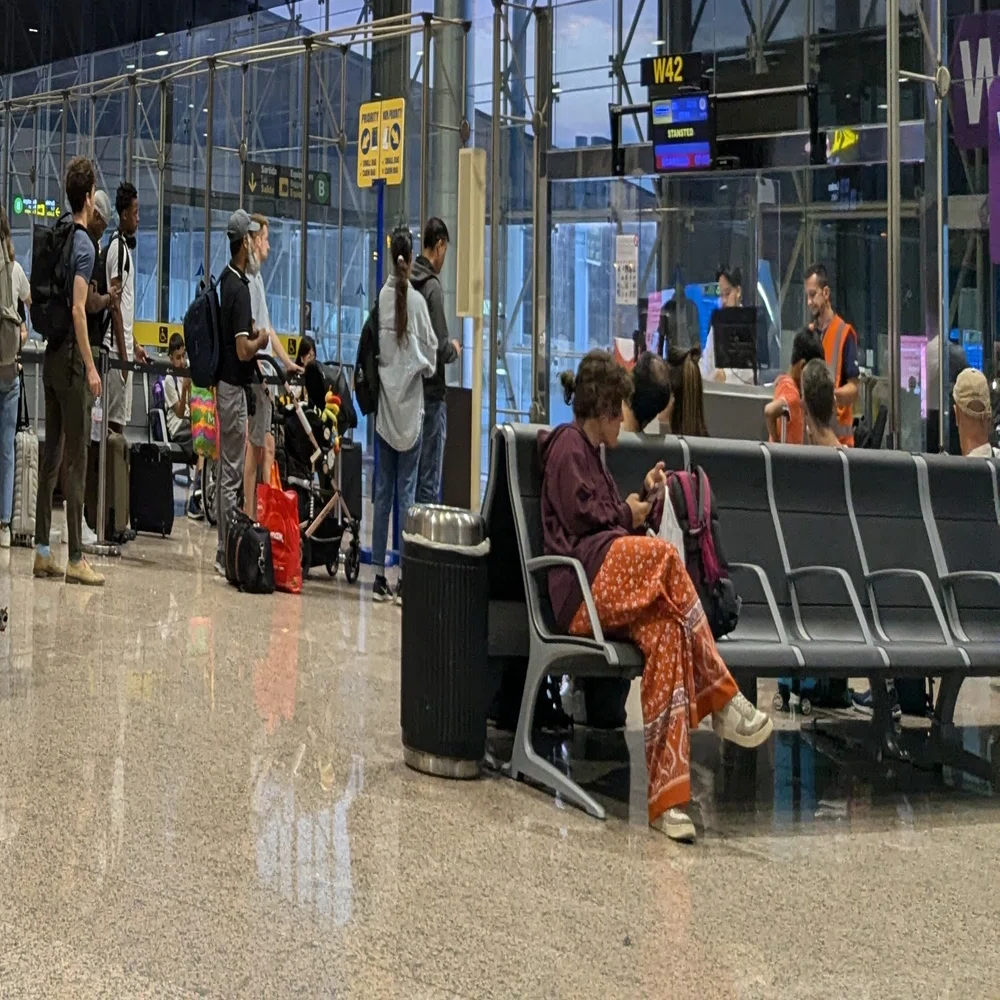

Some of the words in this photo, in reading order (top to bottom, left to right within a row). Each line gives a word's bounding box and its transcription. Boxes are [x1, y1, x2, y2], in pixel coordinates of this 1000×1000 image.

[653, 56, 683, 84] W42
[959, 38, 1000, 124] W
[361, 112, 379, 124] PRIORITY
[667, 127, 694, 138] STANSTED
[319, 180, 325, 196] B
